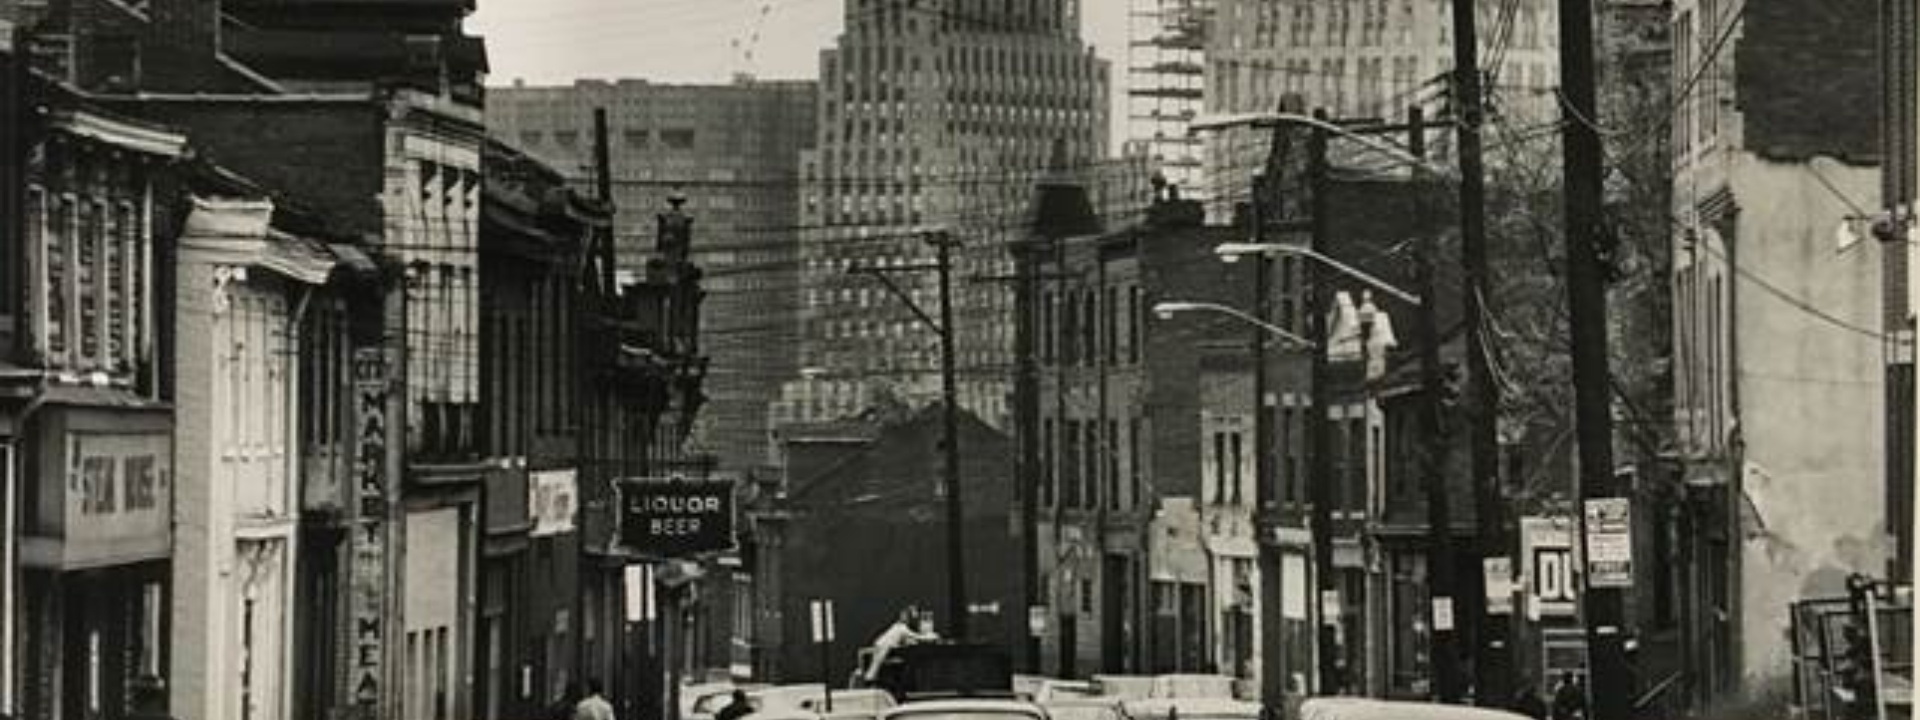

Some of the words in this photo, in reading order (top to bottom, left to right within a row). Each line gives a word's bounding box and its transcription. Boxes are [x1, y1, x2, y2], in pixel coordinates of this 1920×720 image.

[358, 390, 383, 544] MARKET
[630, 495, 720, 514] LIQUOR
[650, 517, 701, 536] BEER
